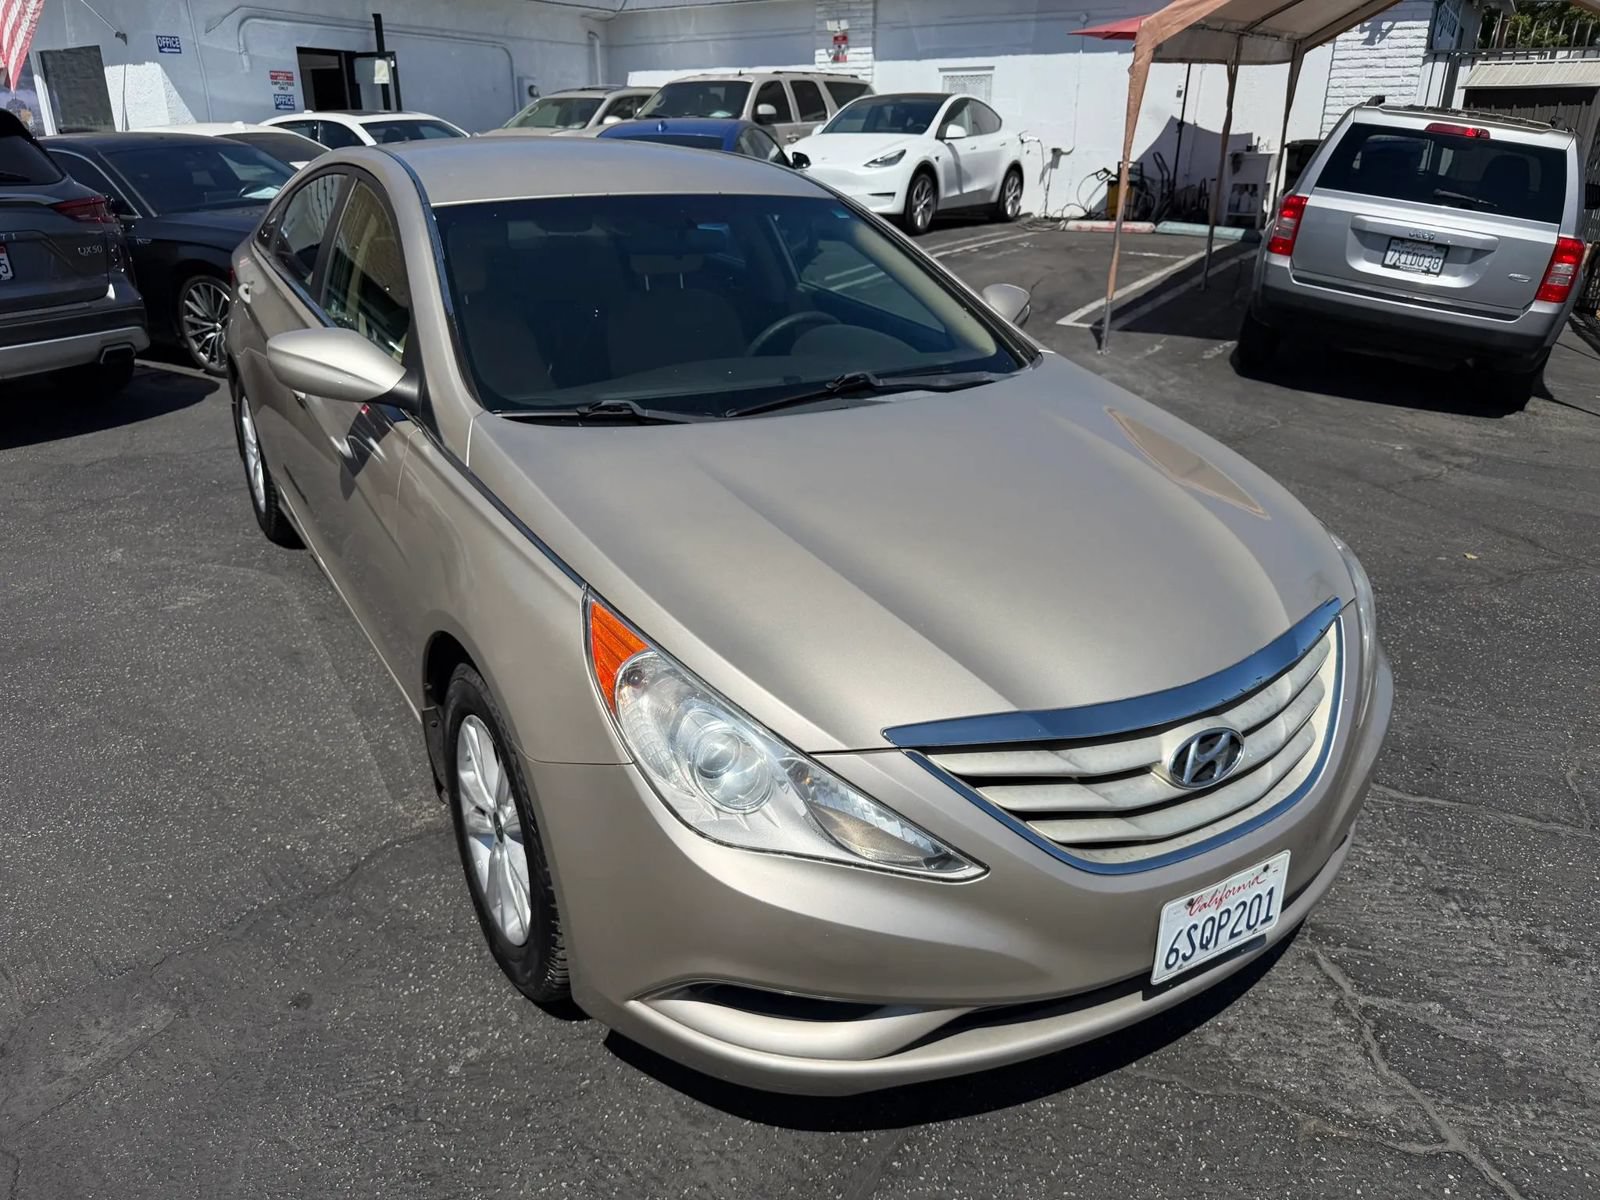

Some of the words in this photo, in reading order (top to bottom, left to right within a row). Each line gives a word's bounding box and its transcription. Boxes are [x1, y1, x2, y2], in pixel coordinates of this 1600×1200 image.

[157, 37, 180, 48] OFFICE
[274, 95, 295, 105] OFFICE
[78, 245, 103, 256] QX50
[1187, 872, 1266, 917] California
[1164, 886, 1275, 970] 6SQP201
